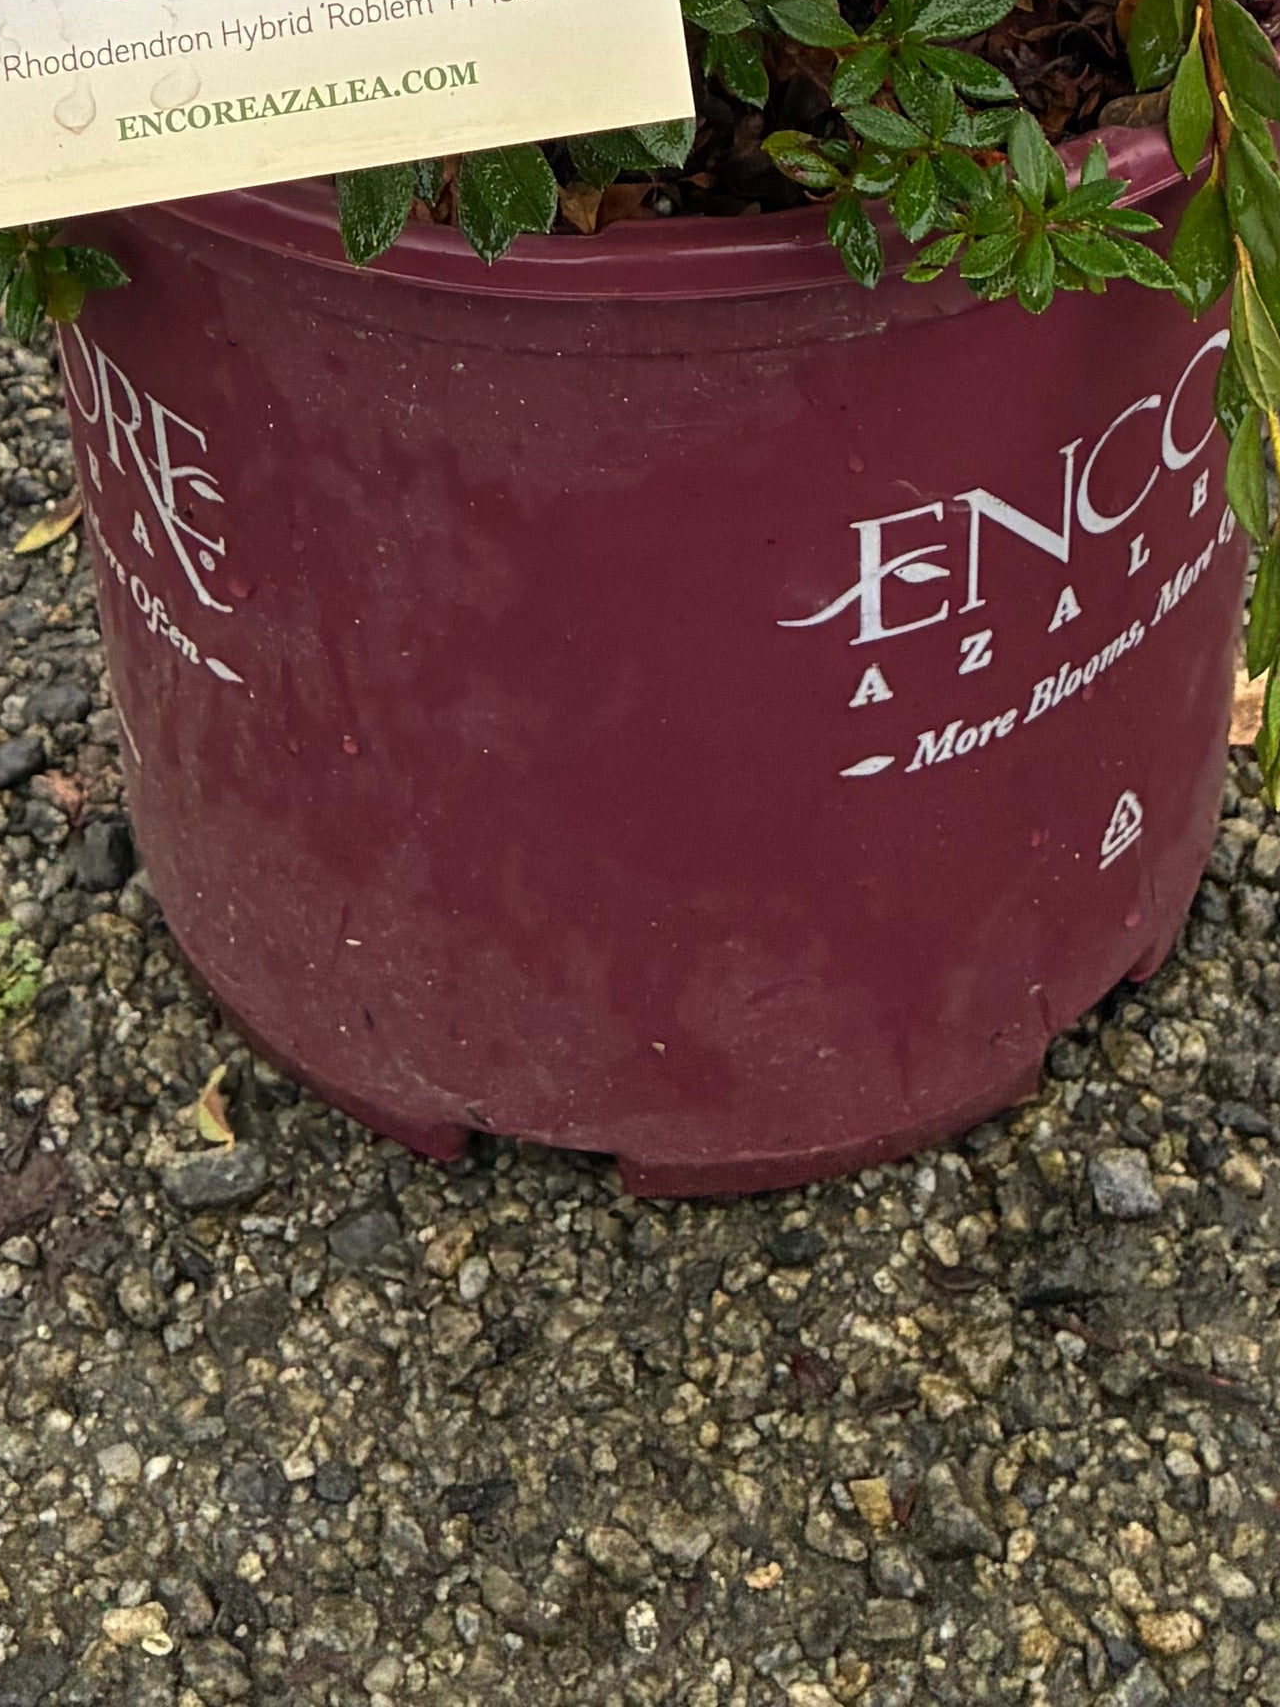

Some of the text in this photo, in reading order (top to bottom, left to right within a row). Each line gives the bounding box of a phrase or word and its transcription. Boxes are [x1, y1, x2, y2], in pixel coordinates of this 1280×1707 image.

[3, 28, 213, 81] Rhododendron
[221, 6, 315, 52] Hybrid
[115, 60, 479, 142] ENCOREAZALEA.COM
[55, 321, 232, 613] ORE
[777, 329, 1230, 646] ENCO
[849, 469, 1209, 708] AZALE
[905, 539, 1214, 774] More Blooms, More
